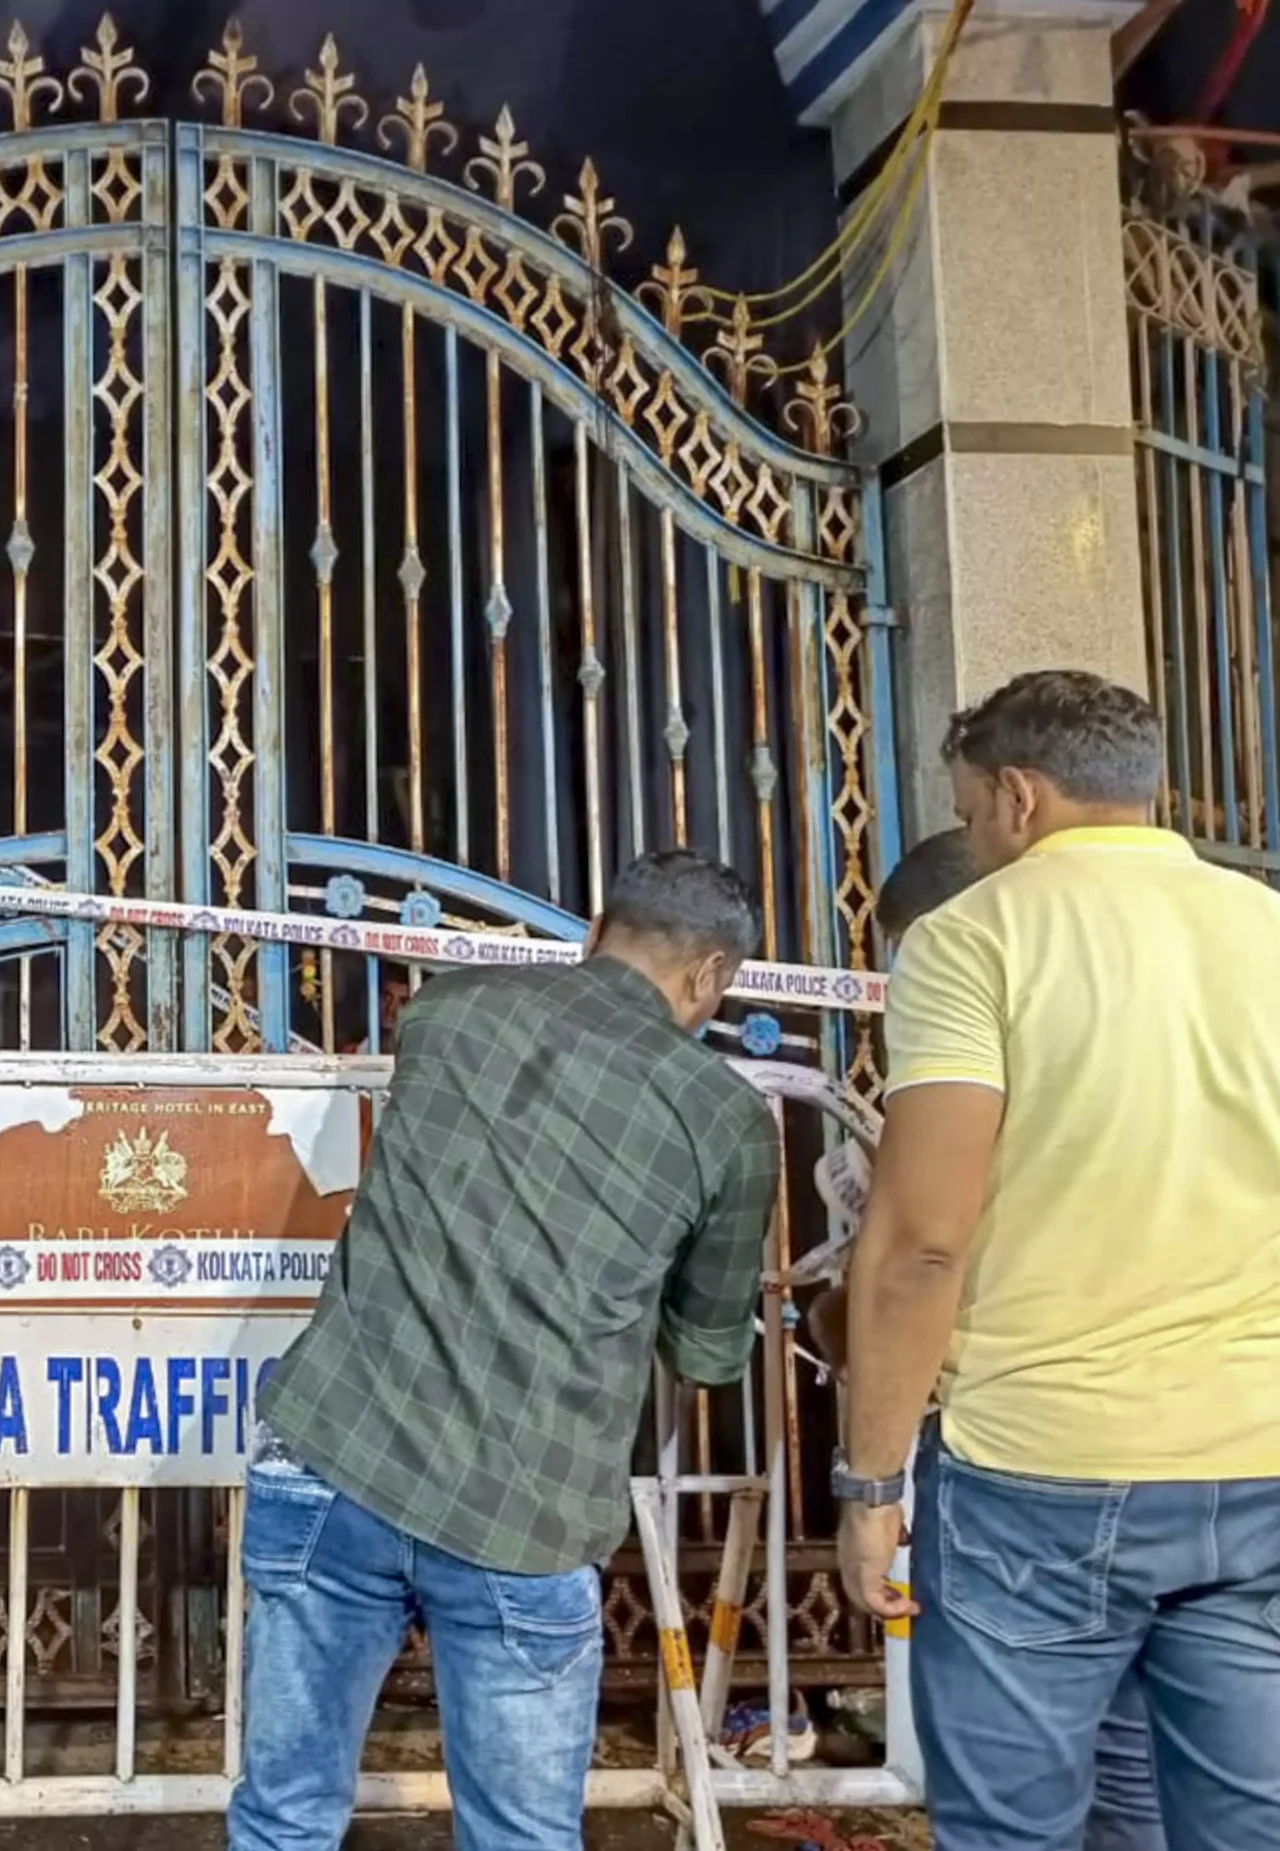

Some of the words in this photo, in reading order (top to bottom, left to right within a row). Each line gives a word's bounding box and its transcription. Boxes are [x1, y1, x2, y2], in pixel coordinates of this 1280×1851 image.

[404, 934, 439, 955] CROSS
[736, 968, 783, 994] OLKATA
[786, 974, 827, 997] POLICE
[866, 982, 882, 1001] DO
[83, 1101, 149, 1113] ERITAGE
[154, 1102, 201, 1114] HOTEL
[207, 1103, 223, 1114] IN
[229, 1103, 266, 1115] EAST
[37, 1252, 58, 1282] DO
[61, 1252, 90, 1282] NOT
[94, 1252, 142, 1282] CROSS
[197, 1252, 275, 1282] KOLKATA
